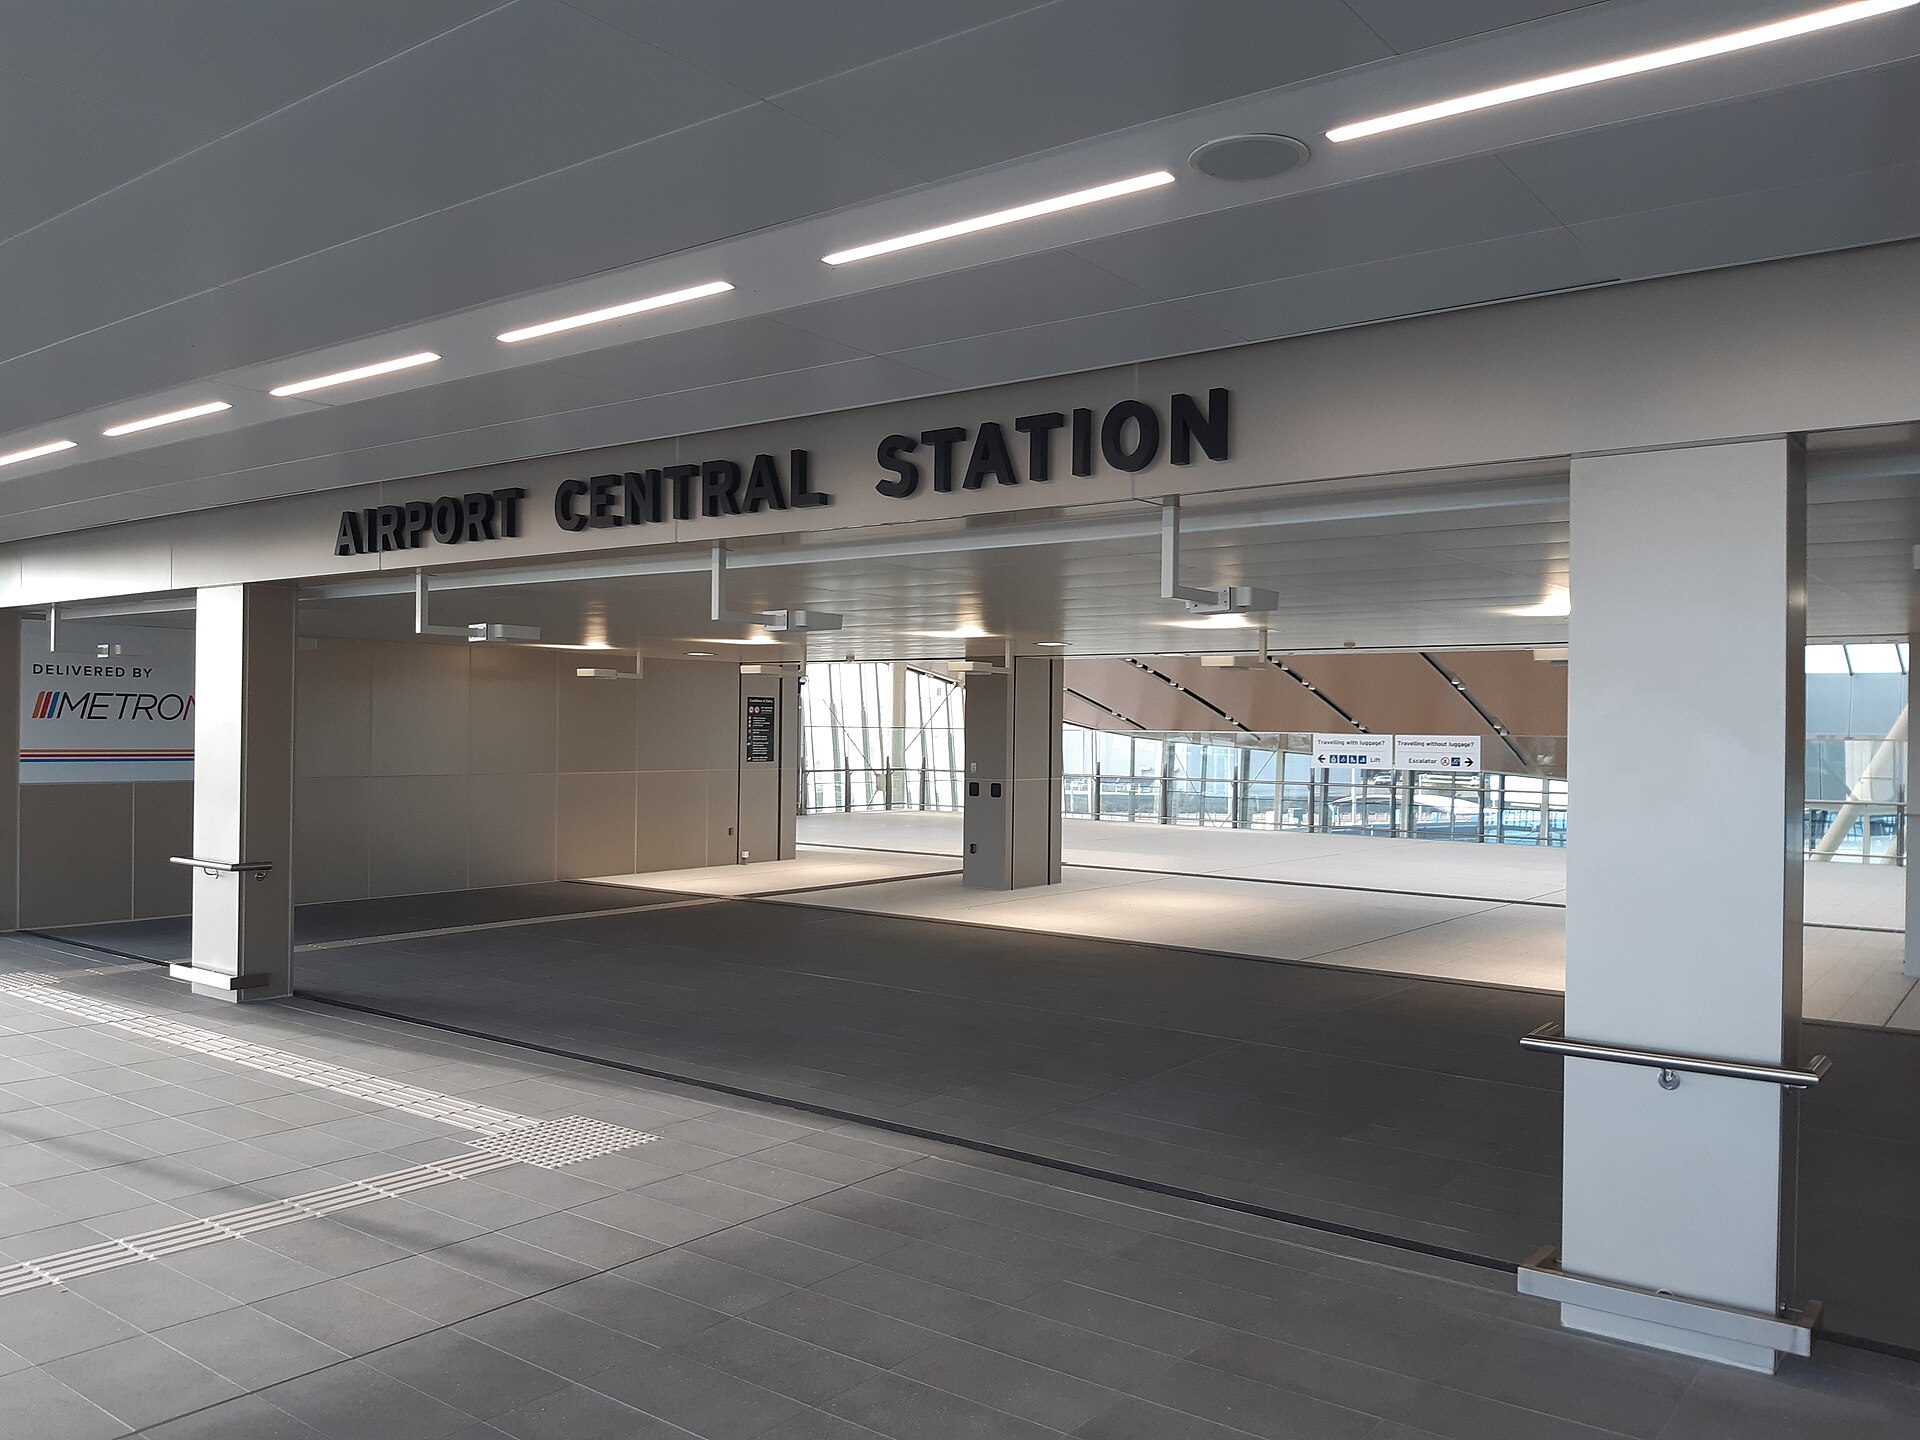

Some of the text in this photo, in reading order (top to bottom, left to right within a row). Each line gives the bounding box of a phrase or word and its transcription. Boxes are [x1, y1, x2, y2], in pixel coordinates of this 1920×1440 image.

[334, 387, 1229, 555] AIRPORT CENTRAL STATION
[32, 663, 153, 679] DELIVERED BY
